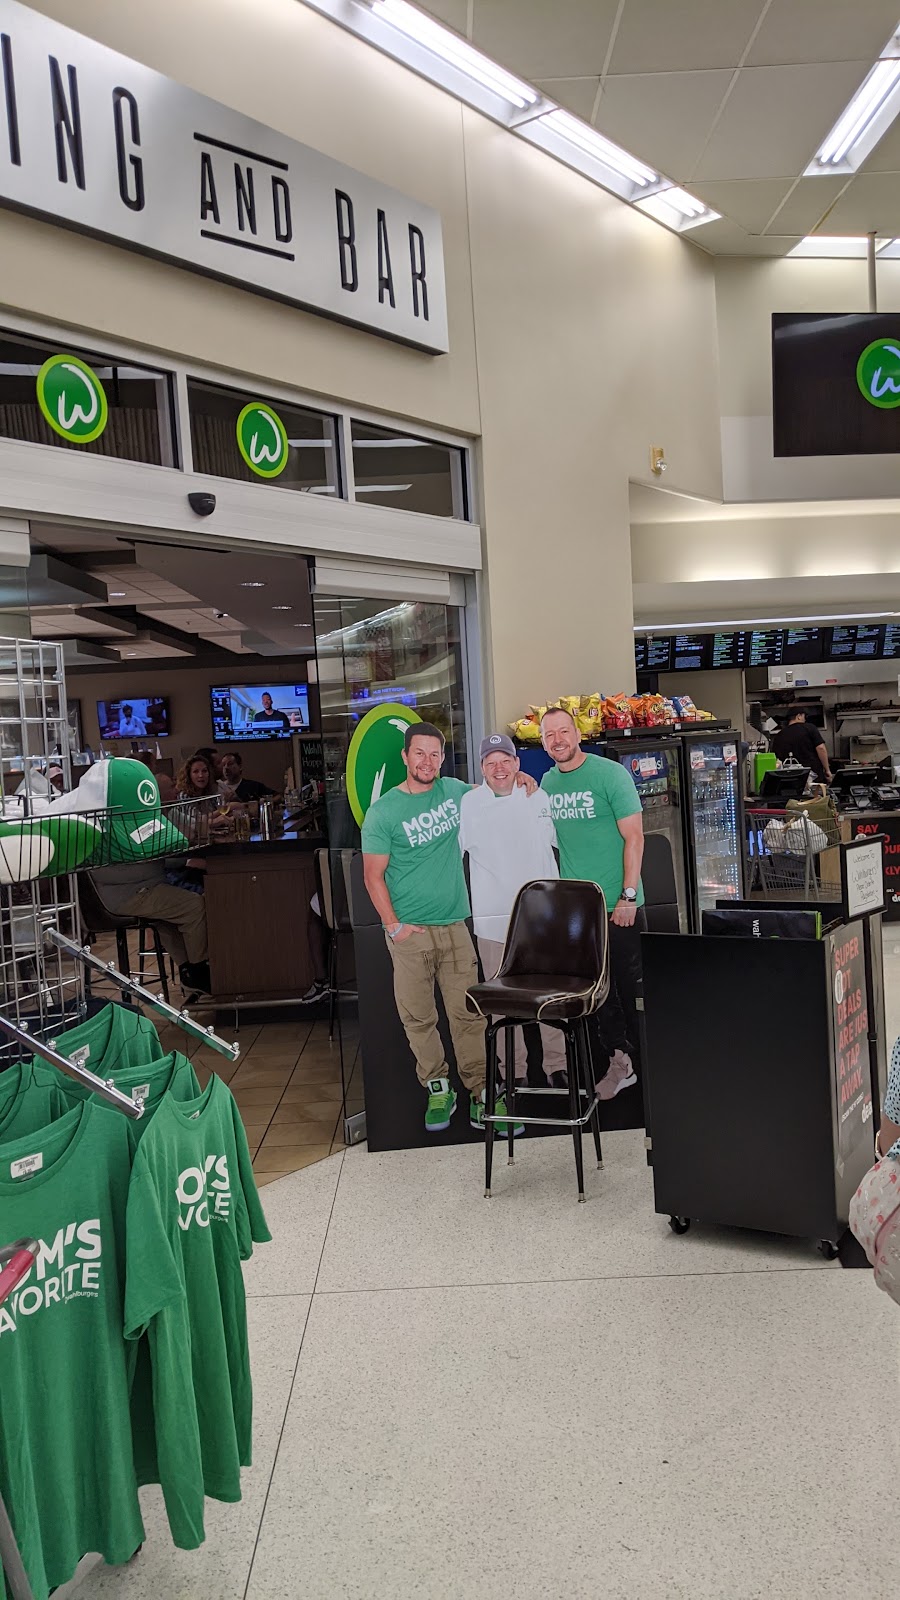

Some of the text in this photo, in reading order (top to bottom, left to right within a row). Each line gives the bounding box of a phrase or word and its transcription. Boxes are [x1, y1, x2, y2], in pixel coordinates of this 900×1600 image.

[200, 152, 293, 244] AND
[335, 188, 430, 322] BAR
[402, 799, 458, 838] MOM'S
[408, 813, 461, 848] FAVORITE
[551, 807, 597, 820] AVORITE
[857, 824, 879, 833] SAY
[835, 936, 859, 970] SUPER
[837, 988, 862, 1025] DEALS
[839, 1021, 854, 1053] ARE
[840, 1043, 860, 1080] A TAP
[841, 1066, 863, 1105] AWAY.
